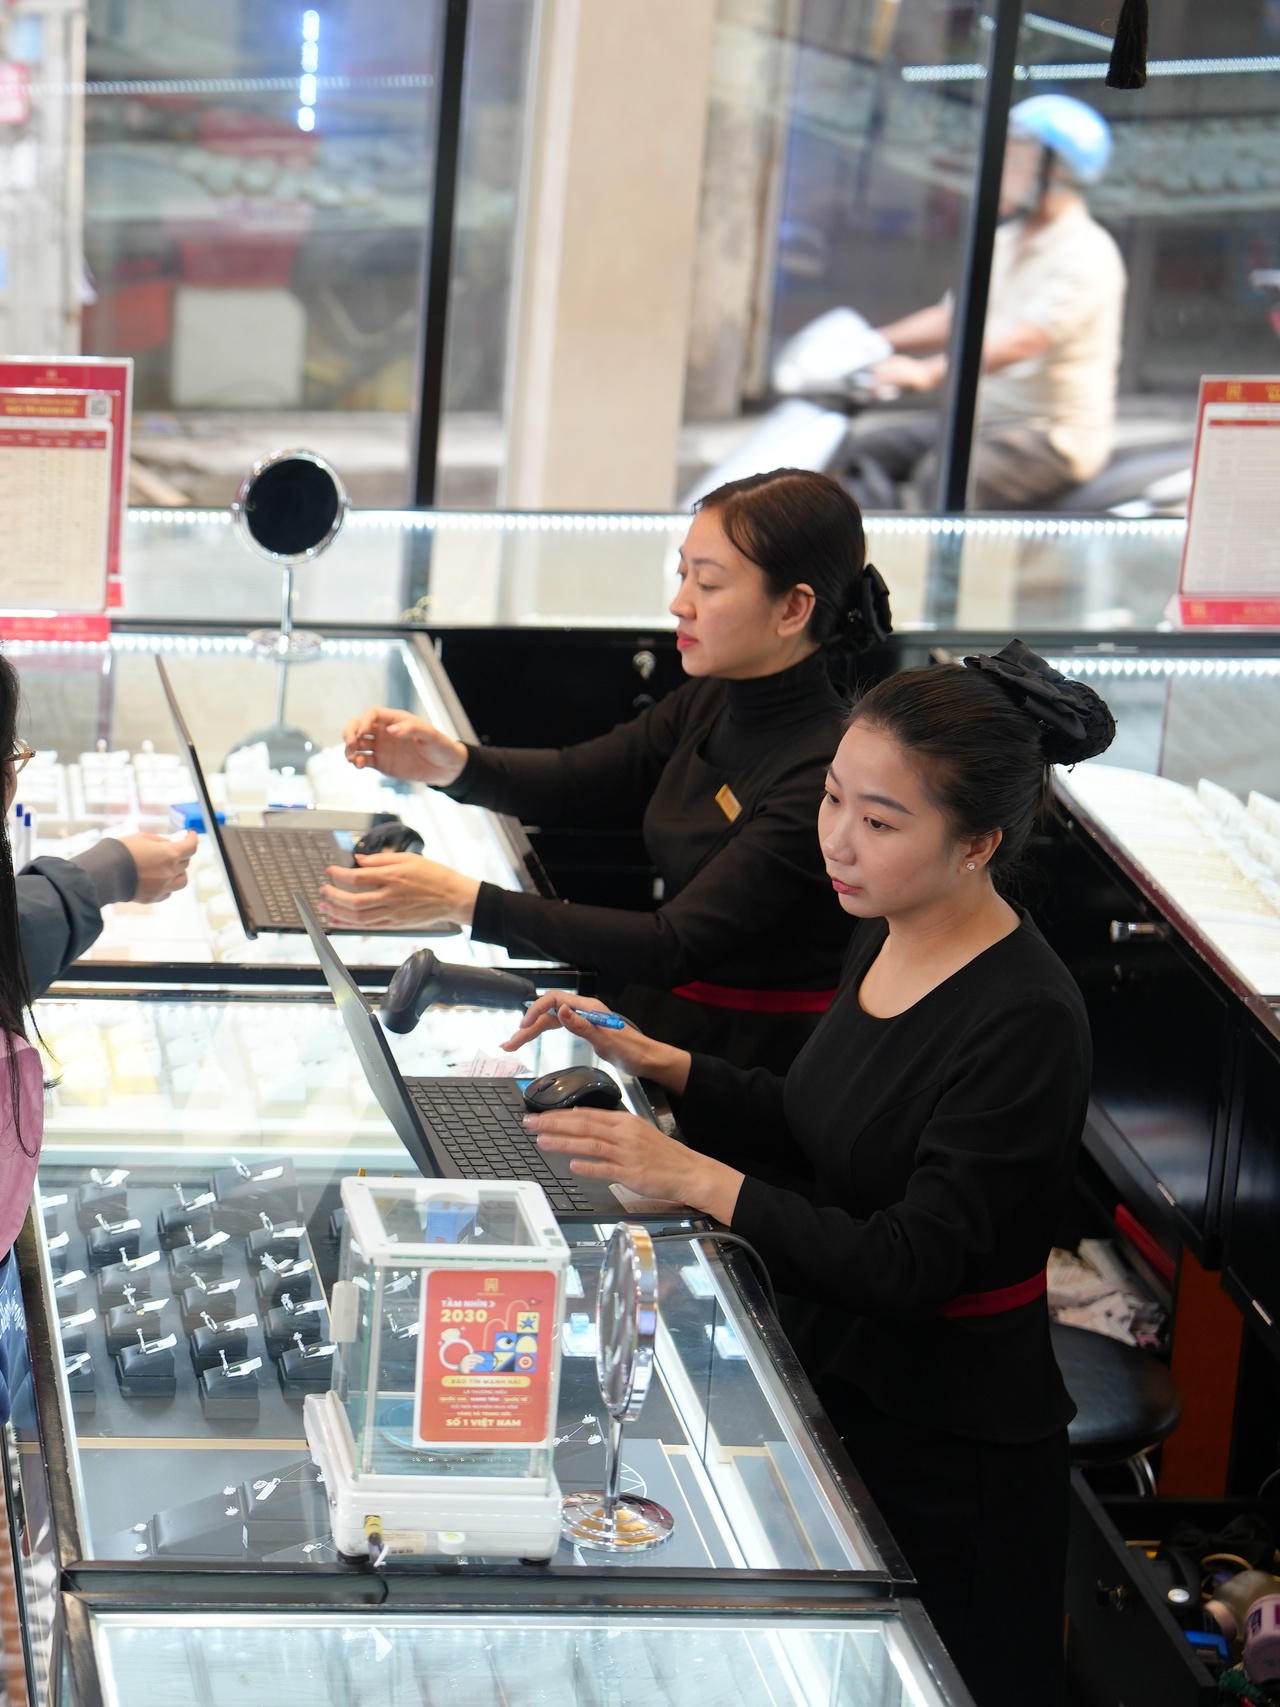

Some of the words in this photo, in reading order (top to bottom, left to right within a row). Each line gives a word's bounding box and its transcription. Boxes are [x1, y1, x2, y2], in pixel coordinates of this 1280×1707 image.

[440, 1309, 488, 1323] 2030
[446, 1416, 461, 1427] SỐ
[463, 1418, 468, 1427] 1
[470, 1417, 494, 1428] VIỆT
[496, 1418, 521, 1427] NAM
